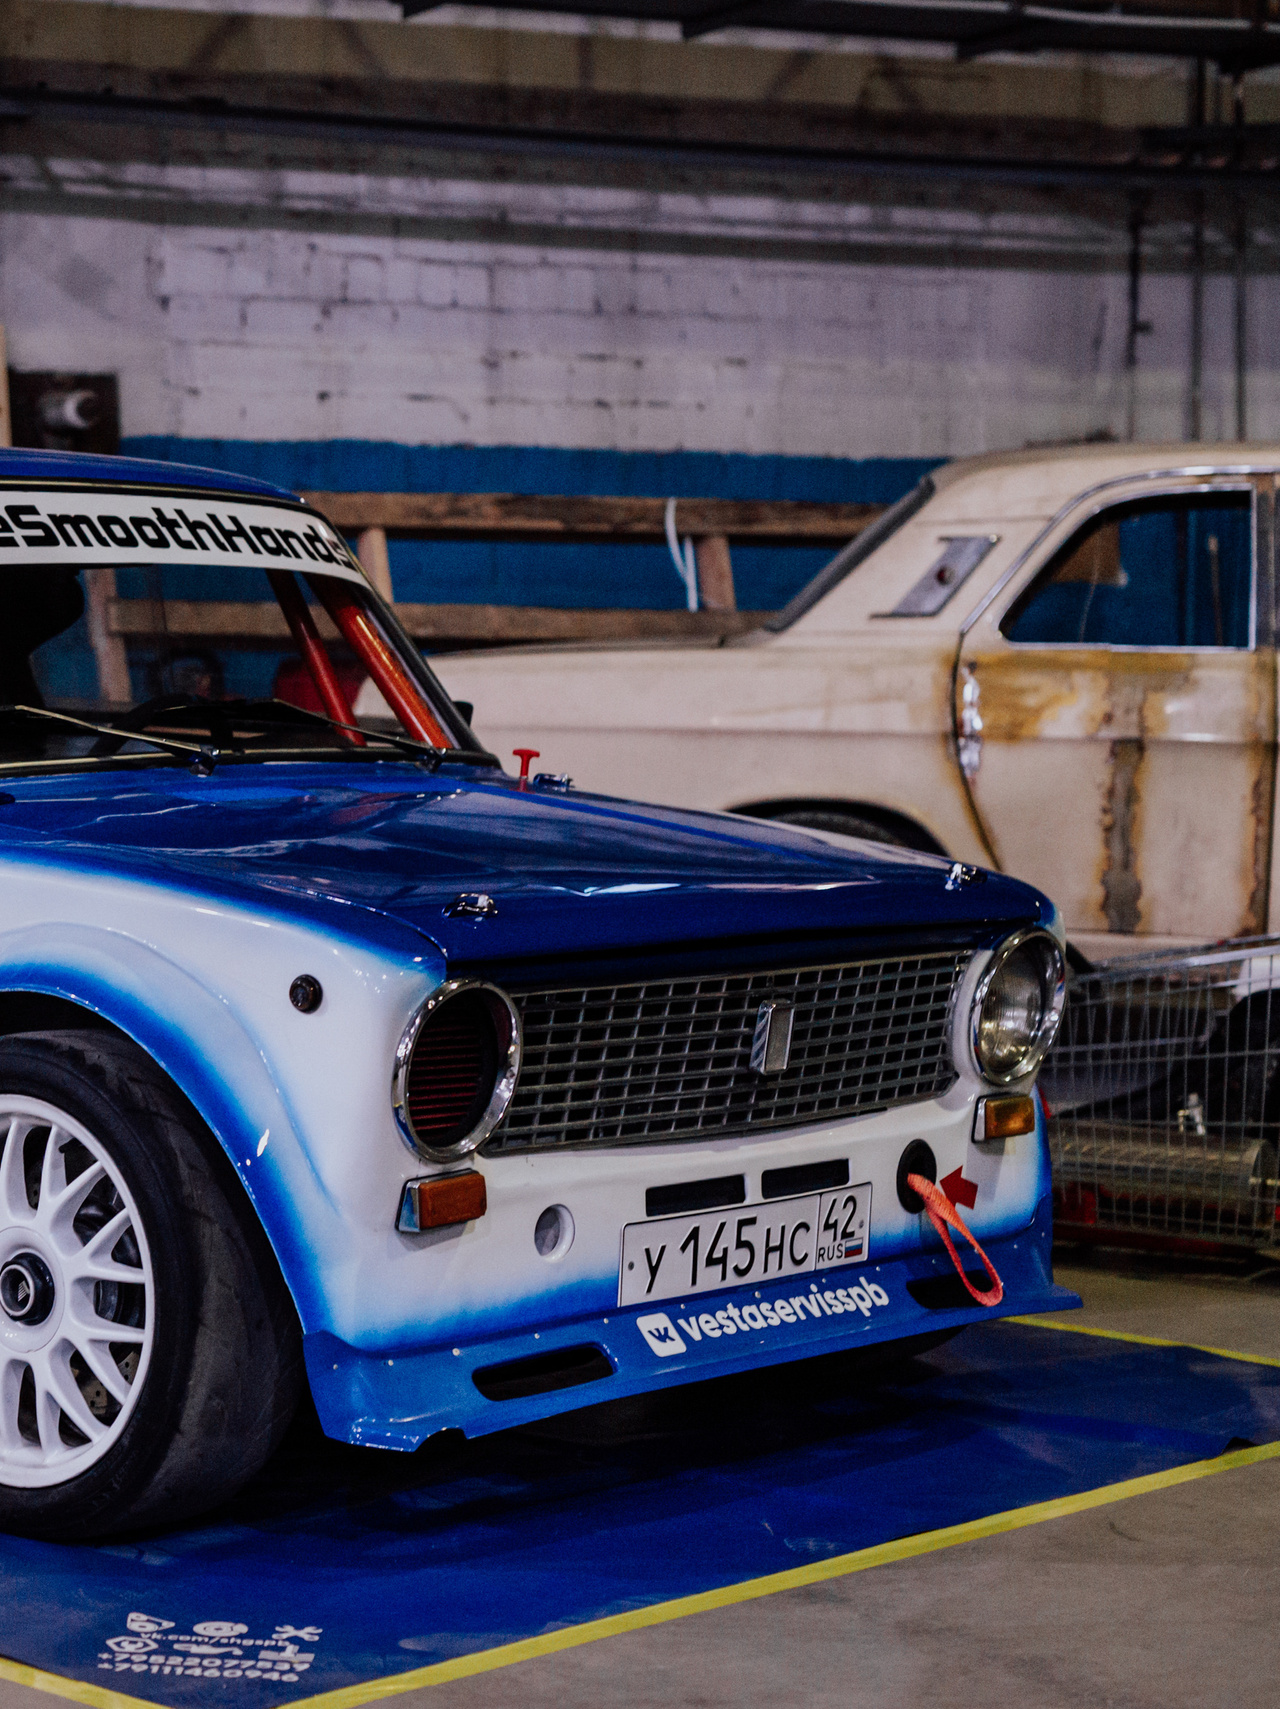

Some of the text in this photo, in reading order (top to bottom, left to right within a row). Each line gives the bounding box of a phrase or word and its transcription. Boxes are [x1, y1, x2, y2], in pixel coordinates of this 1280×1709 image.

[822, 1194, 857, 1243] 42
[817, 1243, 844, 1264] RUS
[677, 1277, 890, 1342] vestaservisspb
